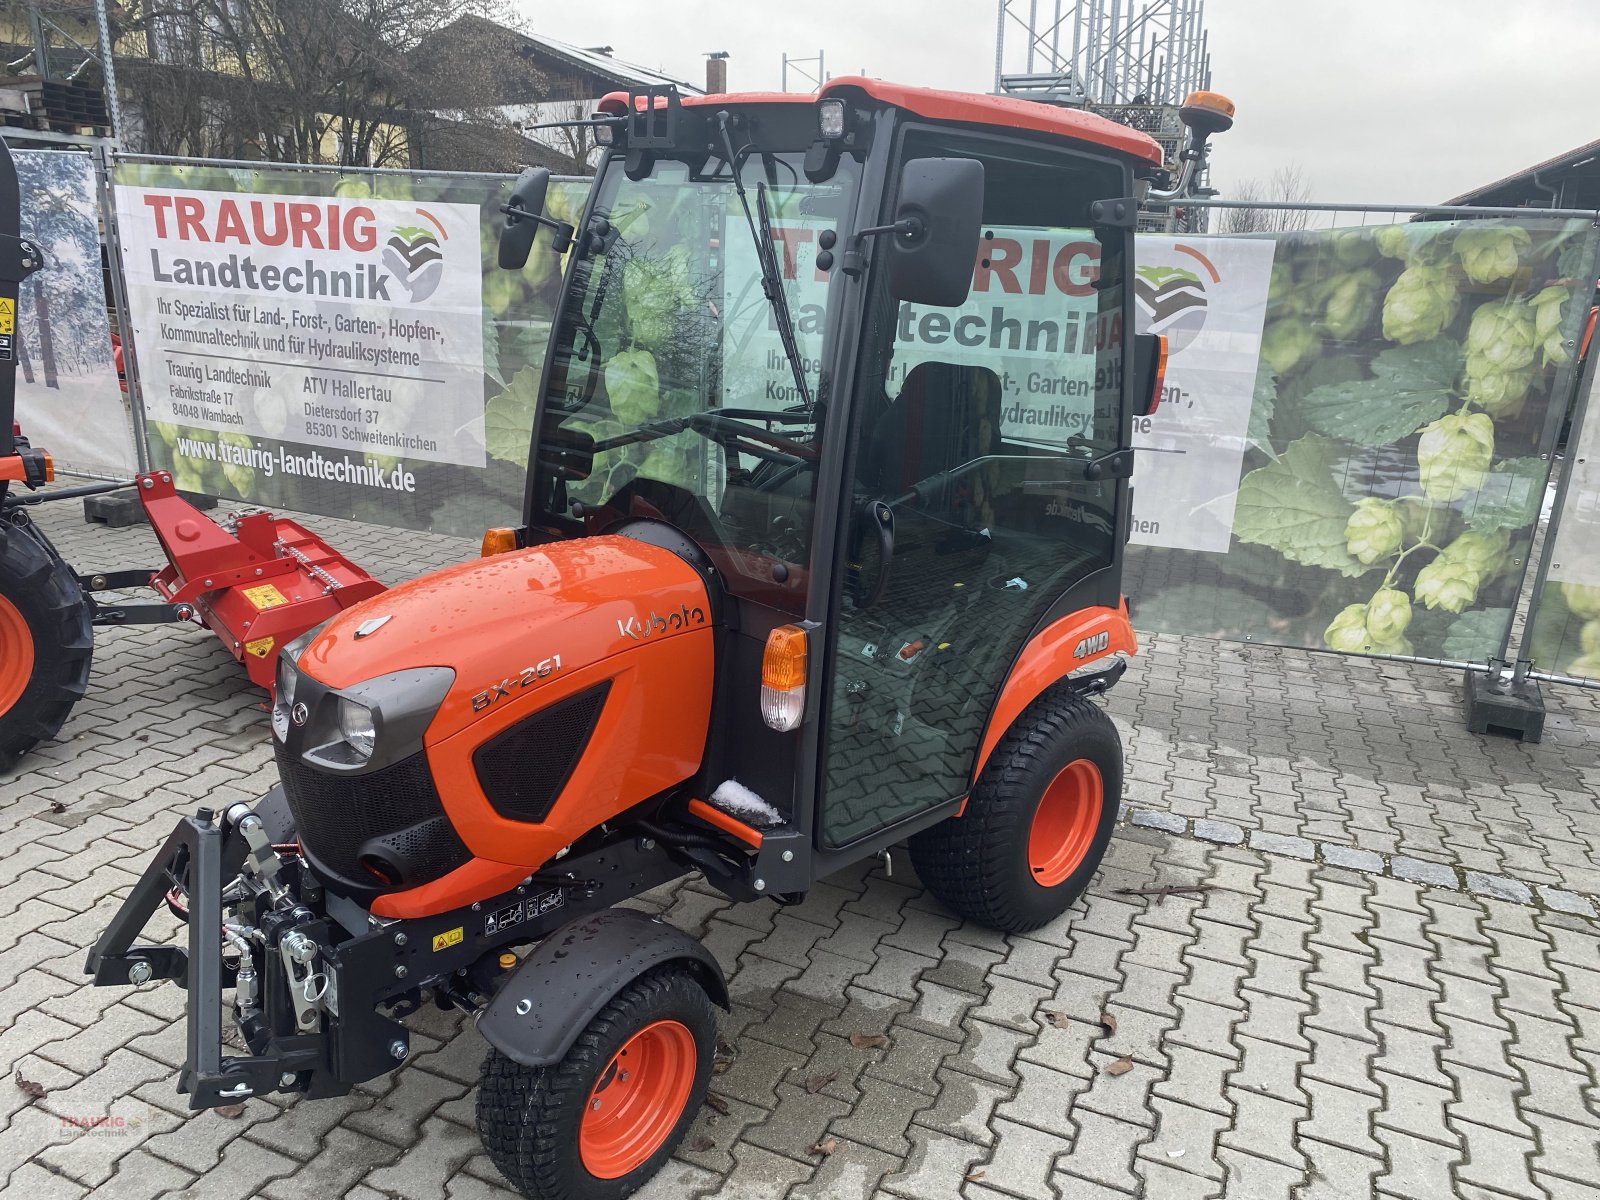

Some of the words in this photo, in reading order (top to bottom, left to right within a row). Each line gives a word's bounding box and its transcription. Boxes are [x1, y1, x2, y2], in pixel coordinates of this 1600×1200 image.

[144, 195, 377, 251] TRAURIG
[150, 248, 391, 301] Landtechnik
[157, 297, 171, 315] Ihr
[174, 300, 231, 321] Spezialist
[233, 304, 250, 322] für
[254, 307, 289, 329] Land-,
[292, 310, 331, 333] Forst-,
[334, 314, 386, 339] Garten-,
[389, 318, 445, 345] Hopfen-,
[160, 323, 260, 350] Kommunaltechnik
[263, 334, 285, 352] und
[288, 335, 305, 354] für
[308, 338, 420, 366] Hydrauliksysteme
[166, 360, 203, 383] Traurig
[205, 364, 272, 388] Landtechnik
[303, 376, 327, 394] ATV
[332, 380, 392, 402] Hallertau
[1027, 372, 1097, 397] Garten-
[169, 385, 221, 404] Fabrikstraße
[223, 392, 233, 405] 17
[172, 402, 199, 419] 84048
[200, 407, 244, 425] Wambach
[304, 402, 361, 422] Dietersdorf
[365, 409, 379, 424] 37
[305, 421, 338, 438] 85301
[341, 426, 437, 451] Schweitenkirchen
[177, 437, 416, 492] www.traurig-landtechnik.de
[617, 603, 705, 640] Kubota
[1073, 631, 1109, 659] 4WD
[471, 653, 562, 713] BX-261
